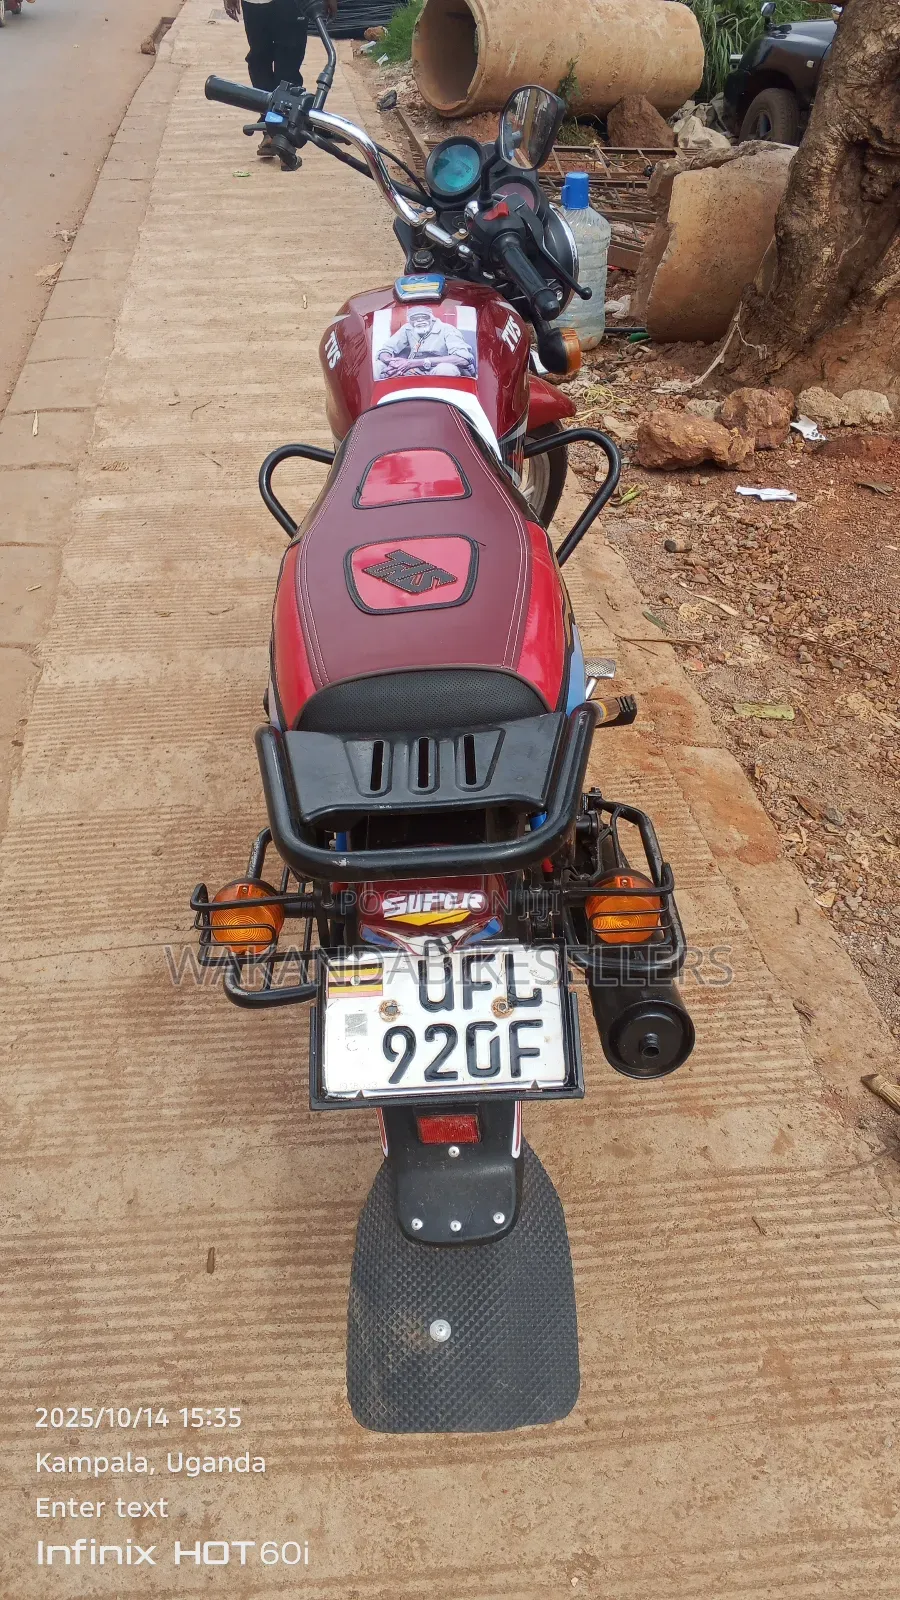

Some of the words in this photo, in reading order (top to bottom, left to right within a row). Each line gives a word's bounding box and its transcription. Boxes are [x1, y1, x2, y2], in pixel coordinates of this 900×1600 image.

[324, 330, 342, 370] TVS
[501, 314, 522, 352] TVS
[382, 892, 483, 918] SUPER
[418, 953, 543, 1012] UFL
[382, 1019, 543, 1084] 920F
